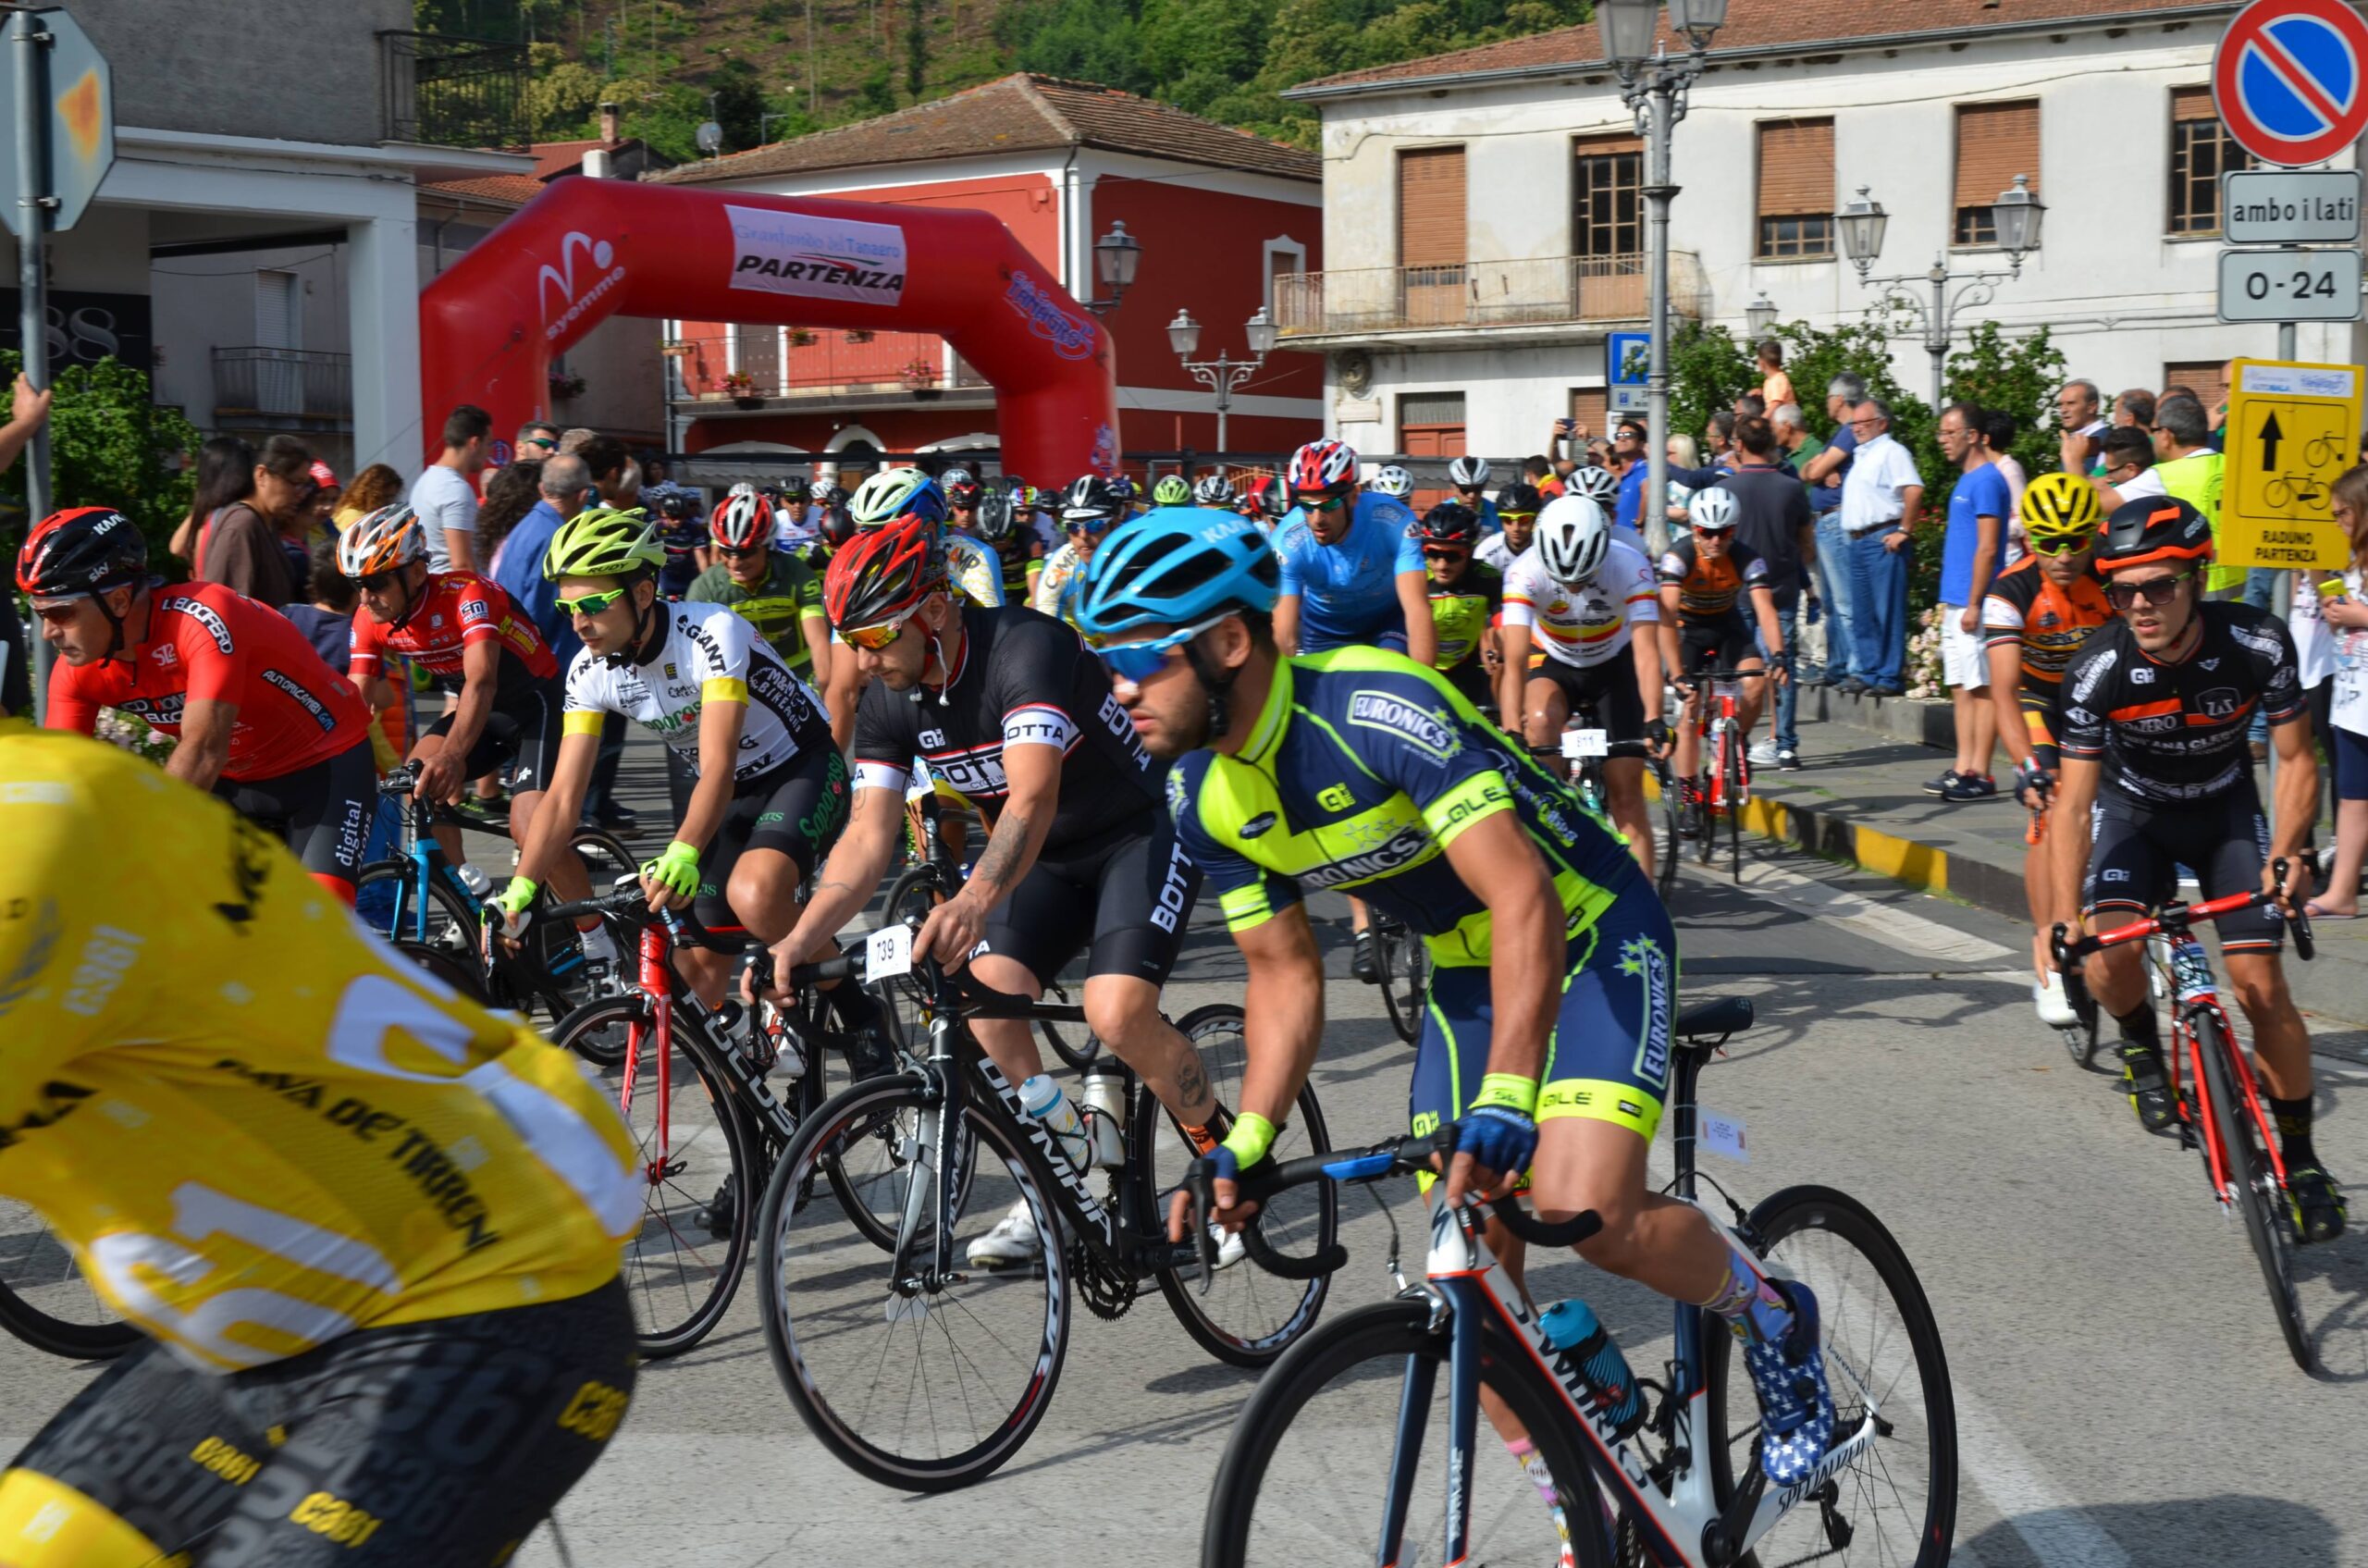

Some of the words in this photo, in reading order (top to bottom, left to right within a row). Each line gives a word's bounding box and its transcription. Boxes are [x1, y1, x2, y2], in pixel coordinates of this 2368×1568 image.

[2233, 197, 2296, 222] ambo
[2302, 197, 2309, 221] i
[2315, 197, 2354, 221] lati
[736, 254, 905, 291] PARTENZA
[944, 543, 980, 574] CAMP
[2255, 547, 2318, 562] PARTENZA
[2263, 530, 2313, 546] RADUNO
[89, 562, 109, 583] sky
[586, 562, 629, 574] RUDY
[1045, 549, 1077, 589] CAMP
[685, 624, 727, 674] GIANT
[262, 670, 322, 715] AUTORICAMBI
[758, 682, 787, 710] BIKE
[767, 667, 796, 696] M&M
[1003, 722, 1064, 742] OTTA
[1355, 696, 1450, 748] EURONICS
[970, 774, 1005, 790] CYCLIN
[335, 799, 364, 867] digital
[357, 811, 373, 874] shops
[1300, 828, 1422, 888] RONICS
[1150, 842, 1193, 935] BOTT
[639, 927, 651, 984] FOCUS
[875, 937, 894, 963] 739
[1643, 953, 1670, 1077] EURONICS
[681, 990, 796, 1137] FOCUS
[977, 1056, 1112, 1247] OLYMPIA
[1505, 1301, 1648, 1488] S-WORKS
[1775, 1436, 1866, 1518] SPECIALIZED
[290, 1490, 383, 1549] C361
